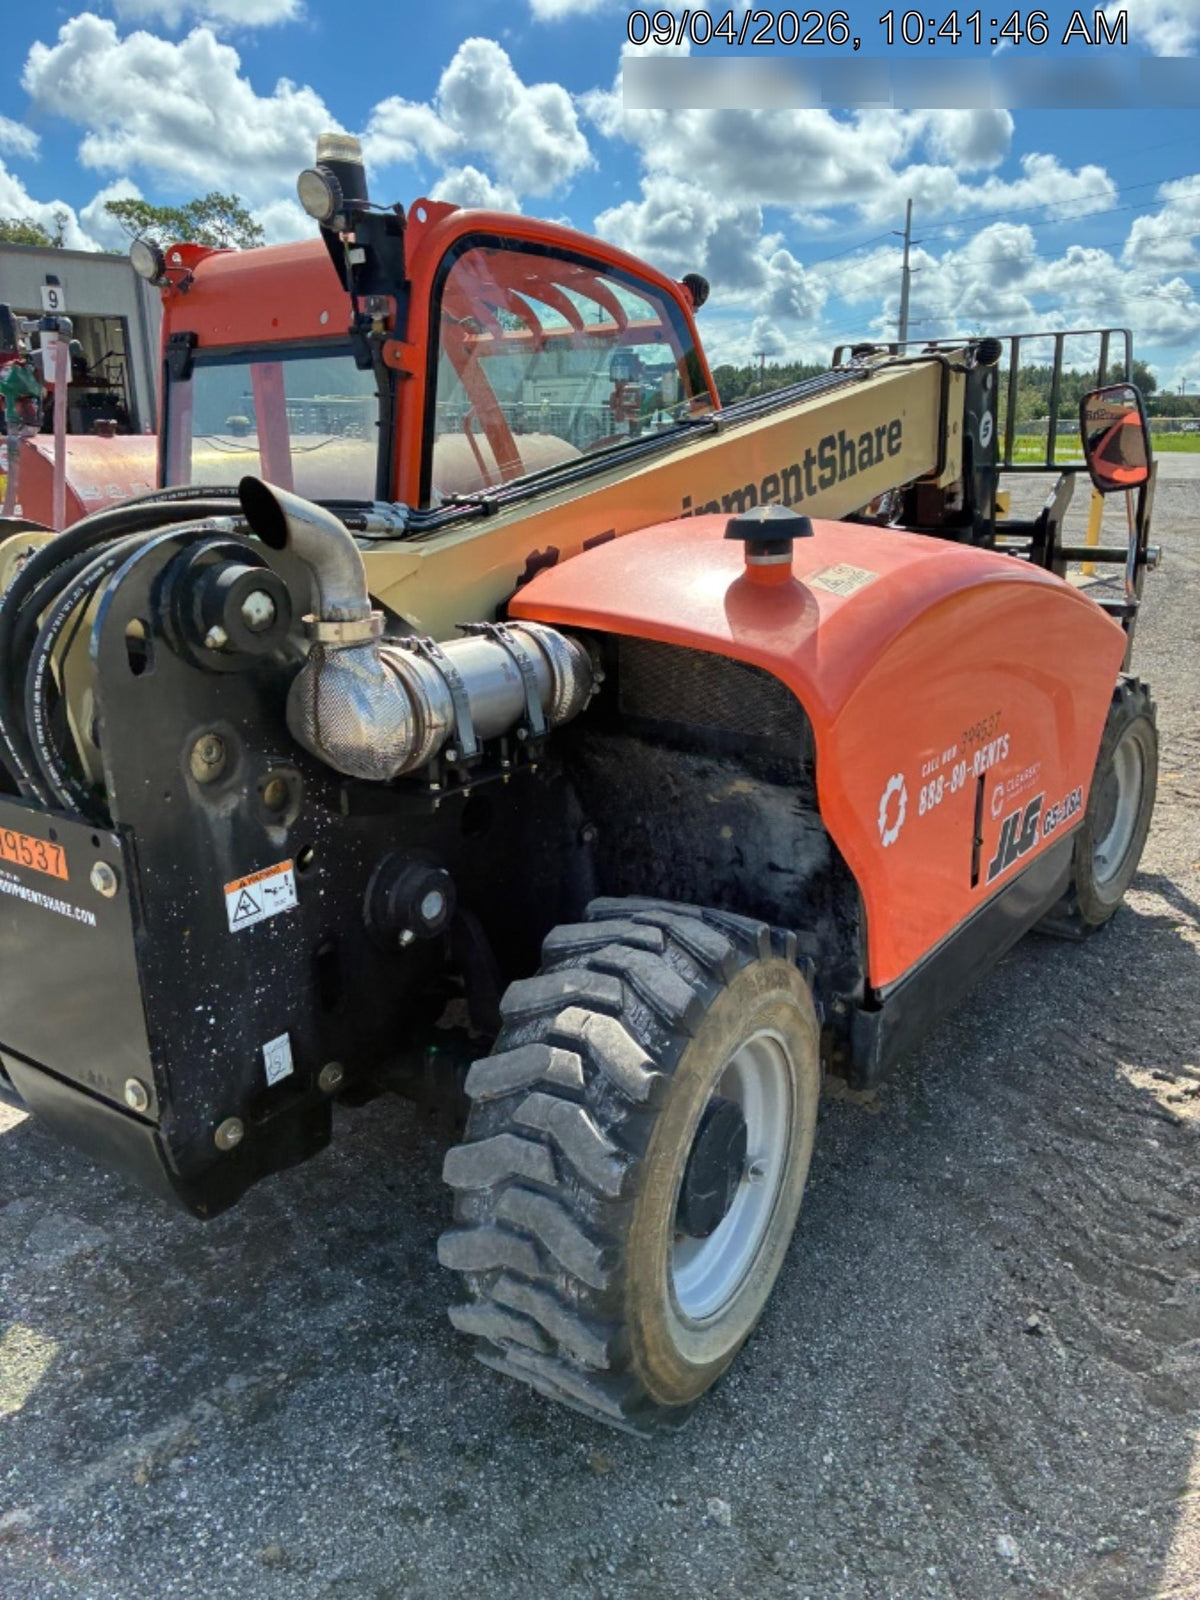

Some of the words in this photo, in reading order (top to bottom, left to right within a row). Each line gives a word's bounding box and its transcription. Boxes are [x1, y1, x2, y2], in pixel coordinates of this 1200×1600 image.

[48, 289, 59, 309] 9
[682, 417, 902, 517] mentShare
[919, 733, 1010, 816] 888-80-RENTS
[922, 758, 940, 778] CALL
[986, 791, 1045, 886] JLG
